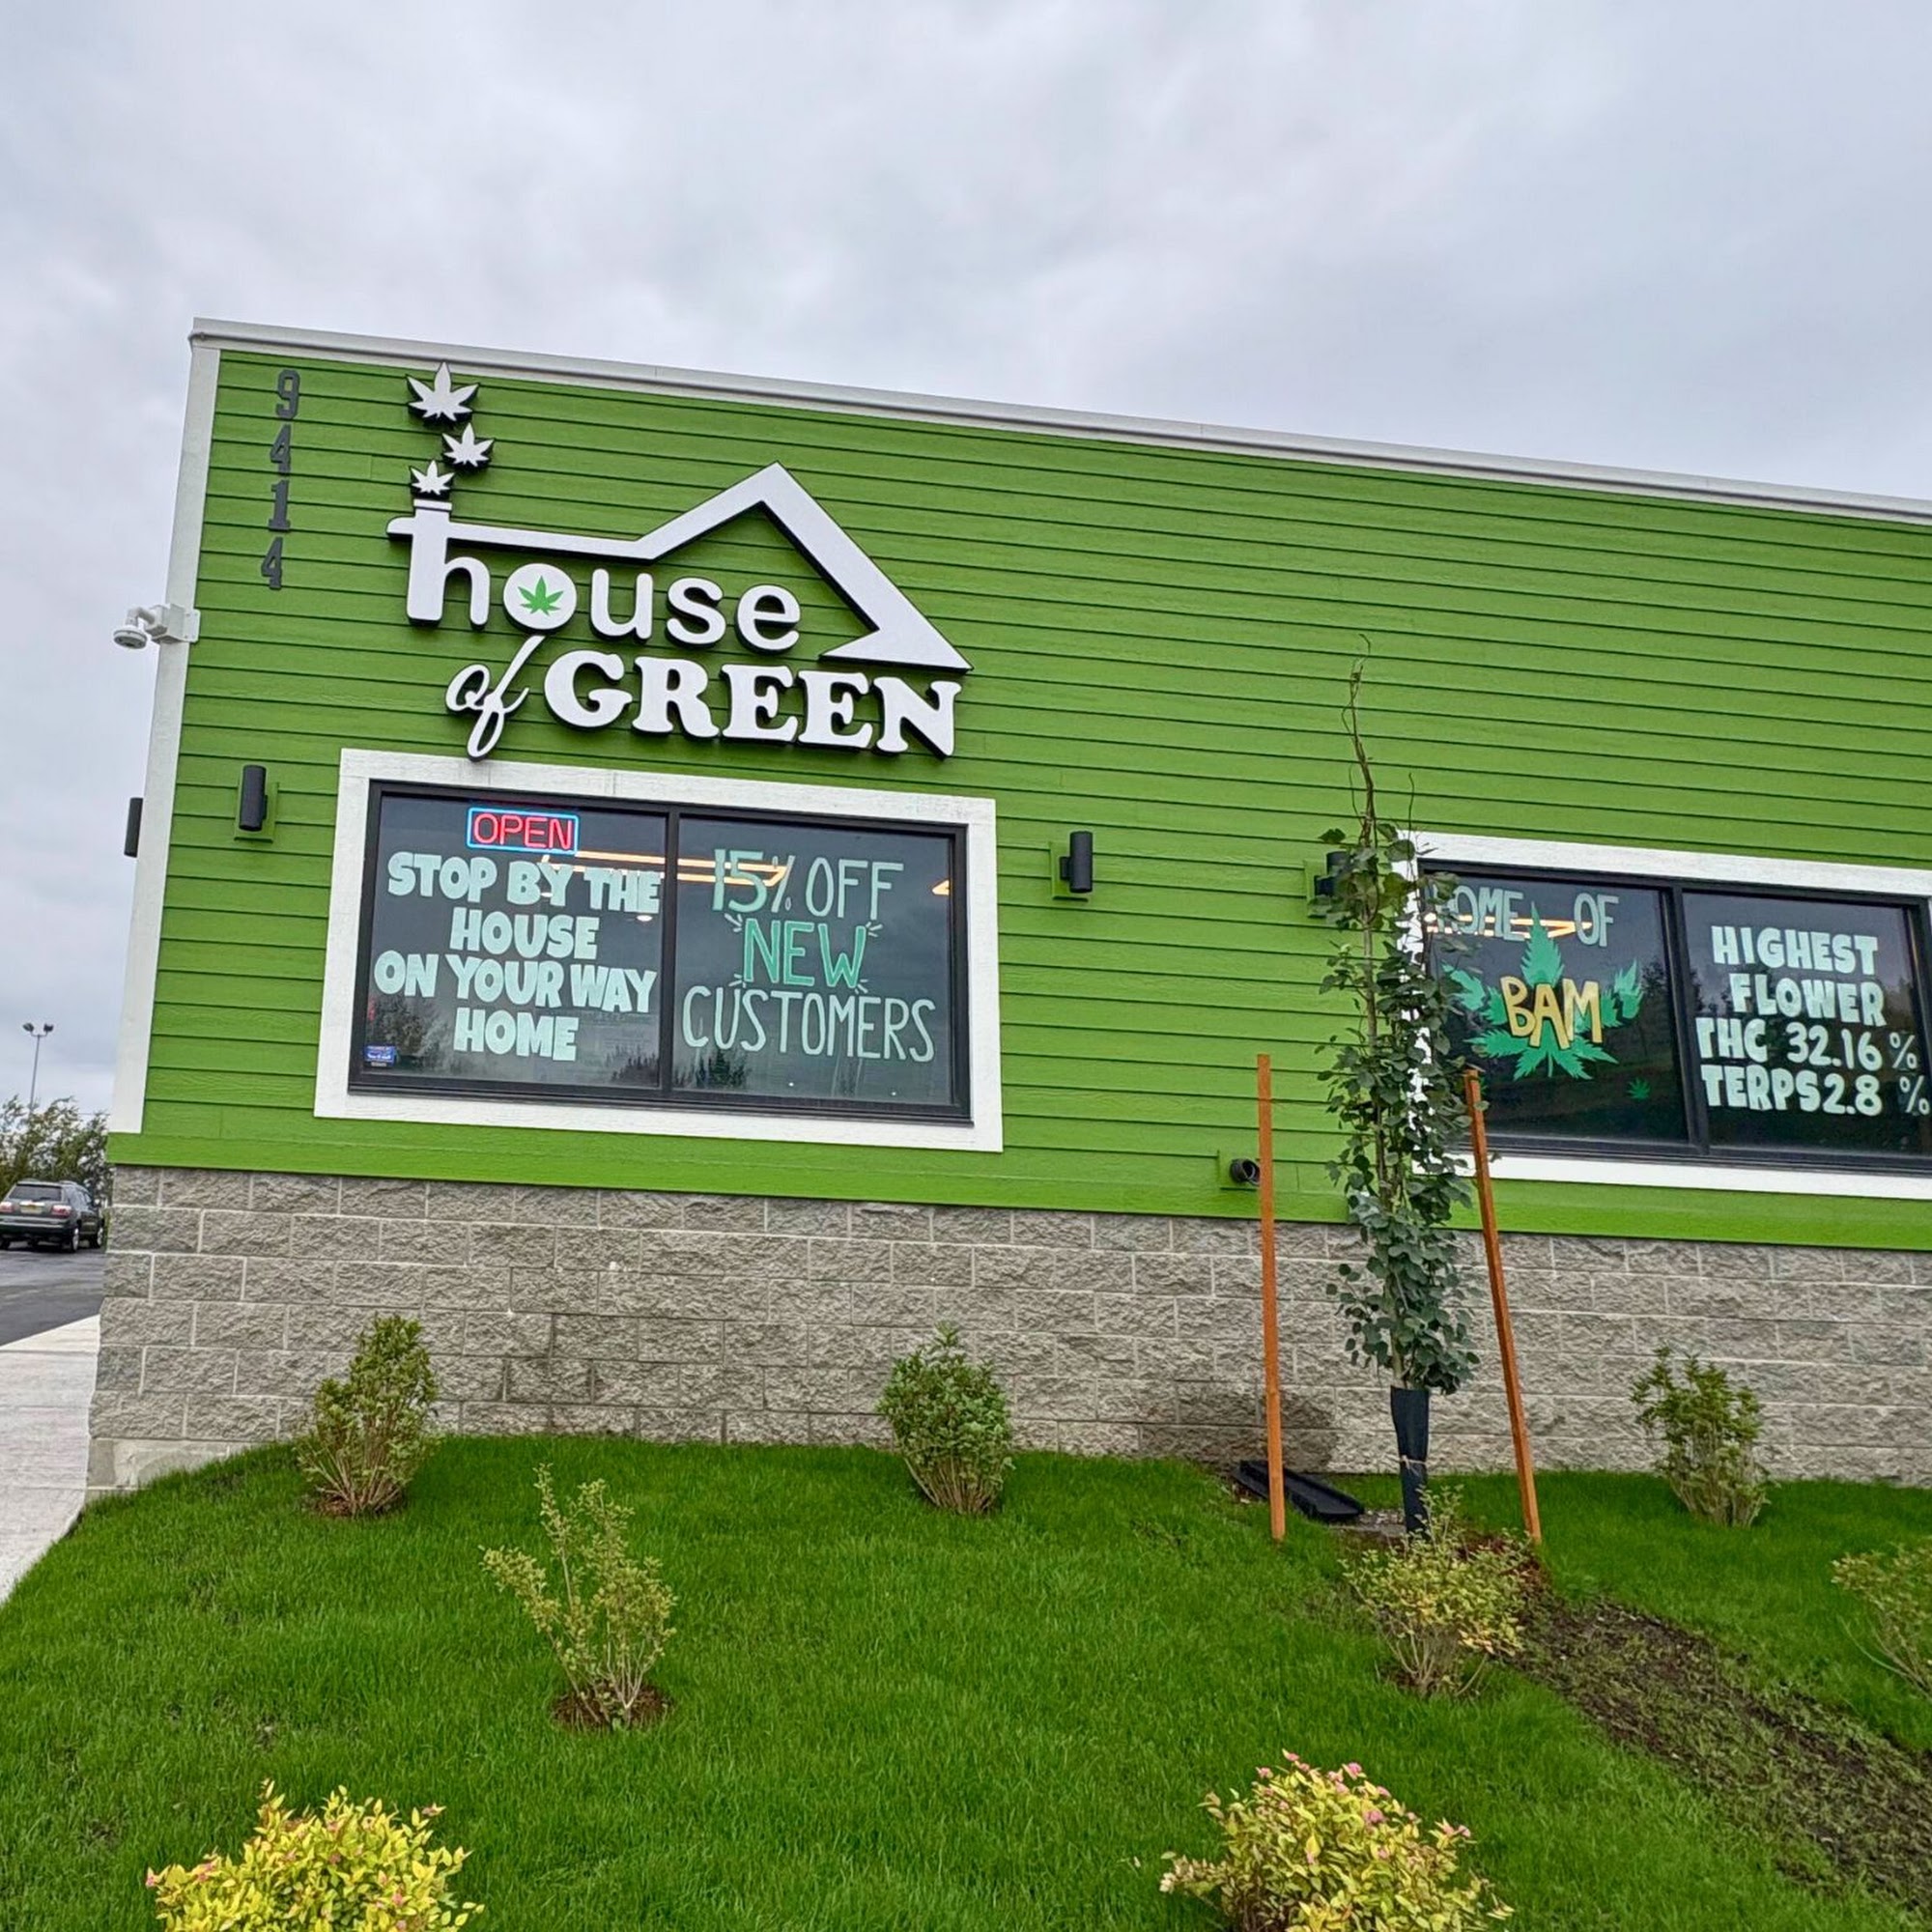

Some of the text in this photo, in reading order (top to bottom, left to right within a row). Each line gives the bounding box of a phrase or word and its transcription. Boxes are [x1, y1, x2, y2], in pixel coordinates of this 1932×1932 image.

[260, 369, 300, 591] 9414
[406, 501, 801, 655] house
[445, 635, 963, 761] of GREEN
[473, 812, 573, 850] OPEN
[387, 851, 662, 914] STOP BY THE
[713, 849, 904, 920] 15% OFF
[449, 907, 600, 959] HOUSE
[1574, 892, 1620, 947] OF
[1711, 925, 1878, 976] HIGHEST
[374, 951, 657, 1013] ON YOUR WAY
[743, 918, 867, 988] NEW
[682, 985, 936, 1062] CUSTOMERS
[1500, 976, 1602, 1050] BAM
[1729, 973, 1887, 1027] FLOWER
[453, 1007, 580, 1061] HOME
[1695, 1017, 1768, 1063] THC
[1786, 1021, 1883, 1071] 32.16
